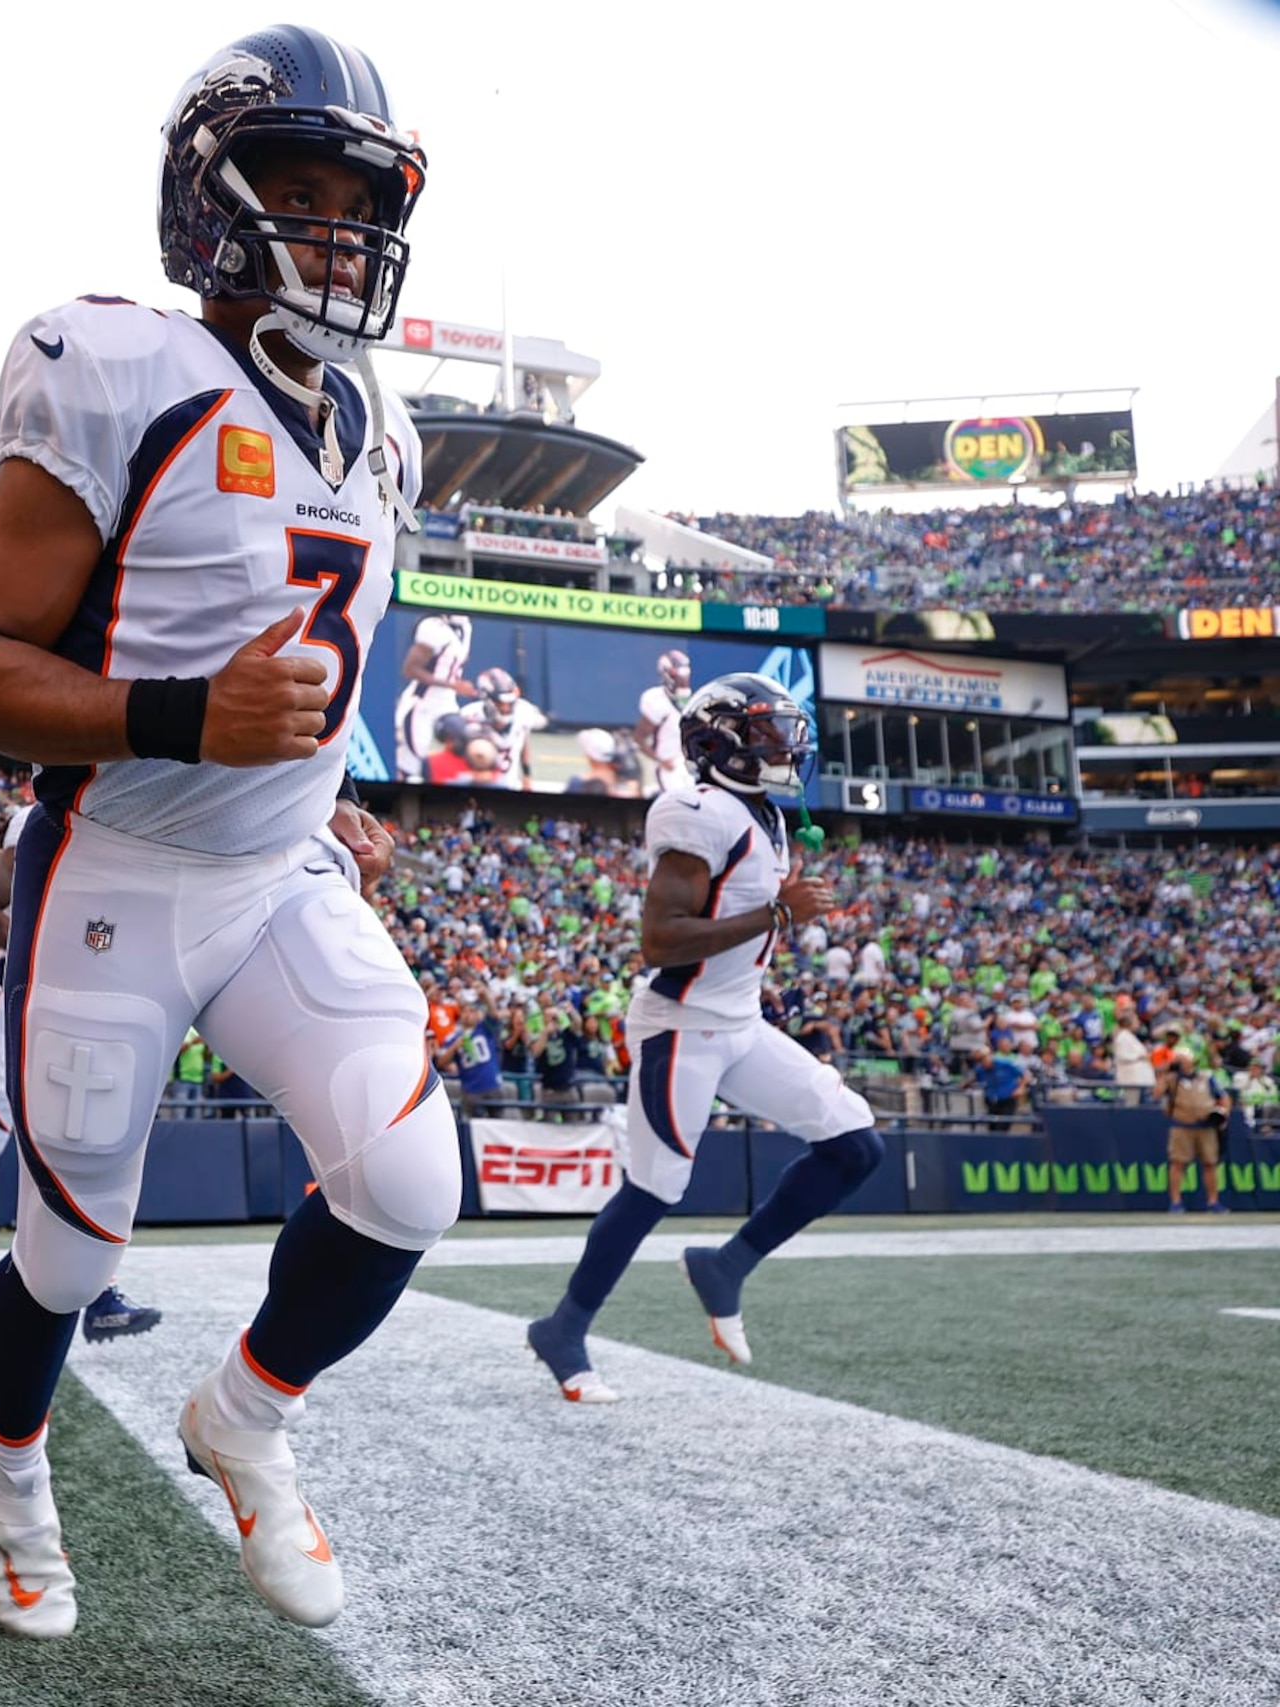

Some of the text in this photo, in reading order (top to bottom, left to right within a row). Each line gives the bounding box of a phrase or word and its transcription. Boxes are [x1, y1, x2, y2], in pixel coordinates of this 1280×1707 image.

[223, 429, 271, 478] C
[954, 434, 1023, 461] DEN
[296, 503, 361, 526] BRONCOS
[475, 535, 602, 560] TOYOTA FAN DECK
[409, 578, 691, 621] COUNTDOWN TO KICKOFF
[285, 527, 372, 747] 3
[1189, 606, 1274, 639] DEN
[866, 670, 1001, 692] AMERICAN FAMILY
[481, 1144, 613, 1187] ESPN
